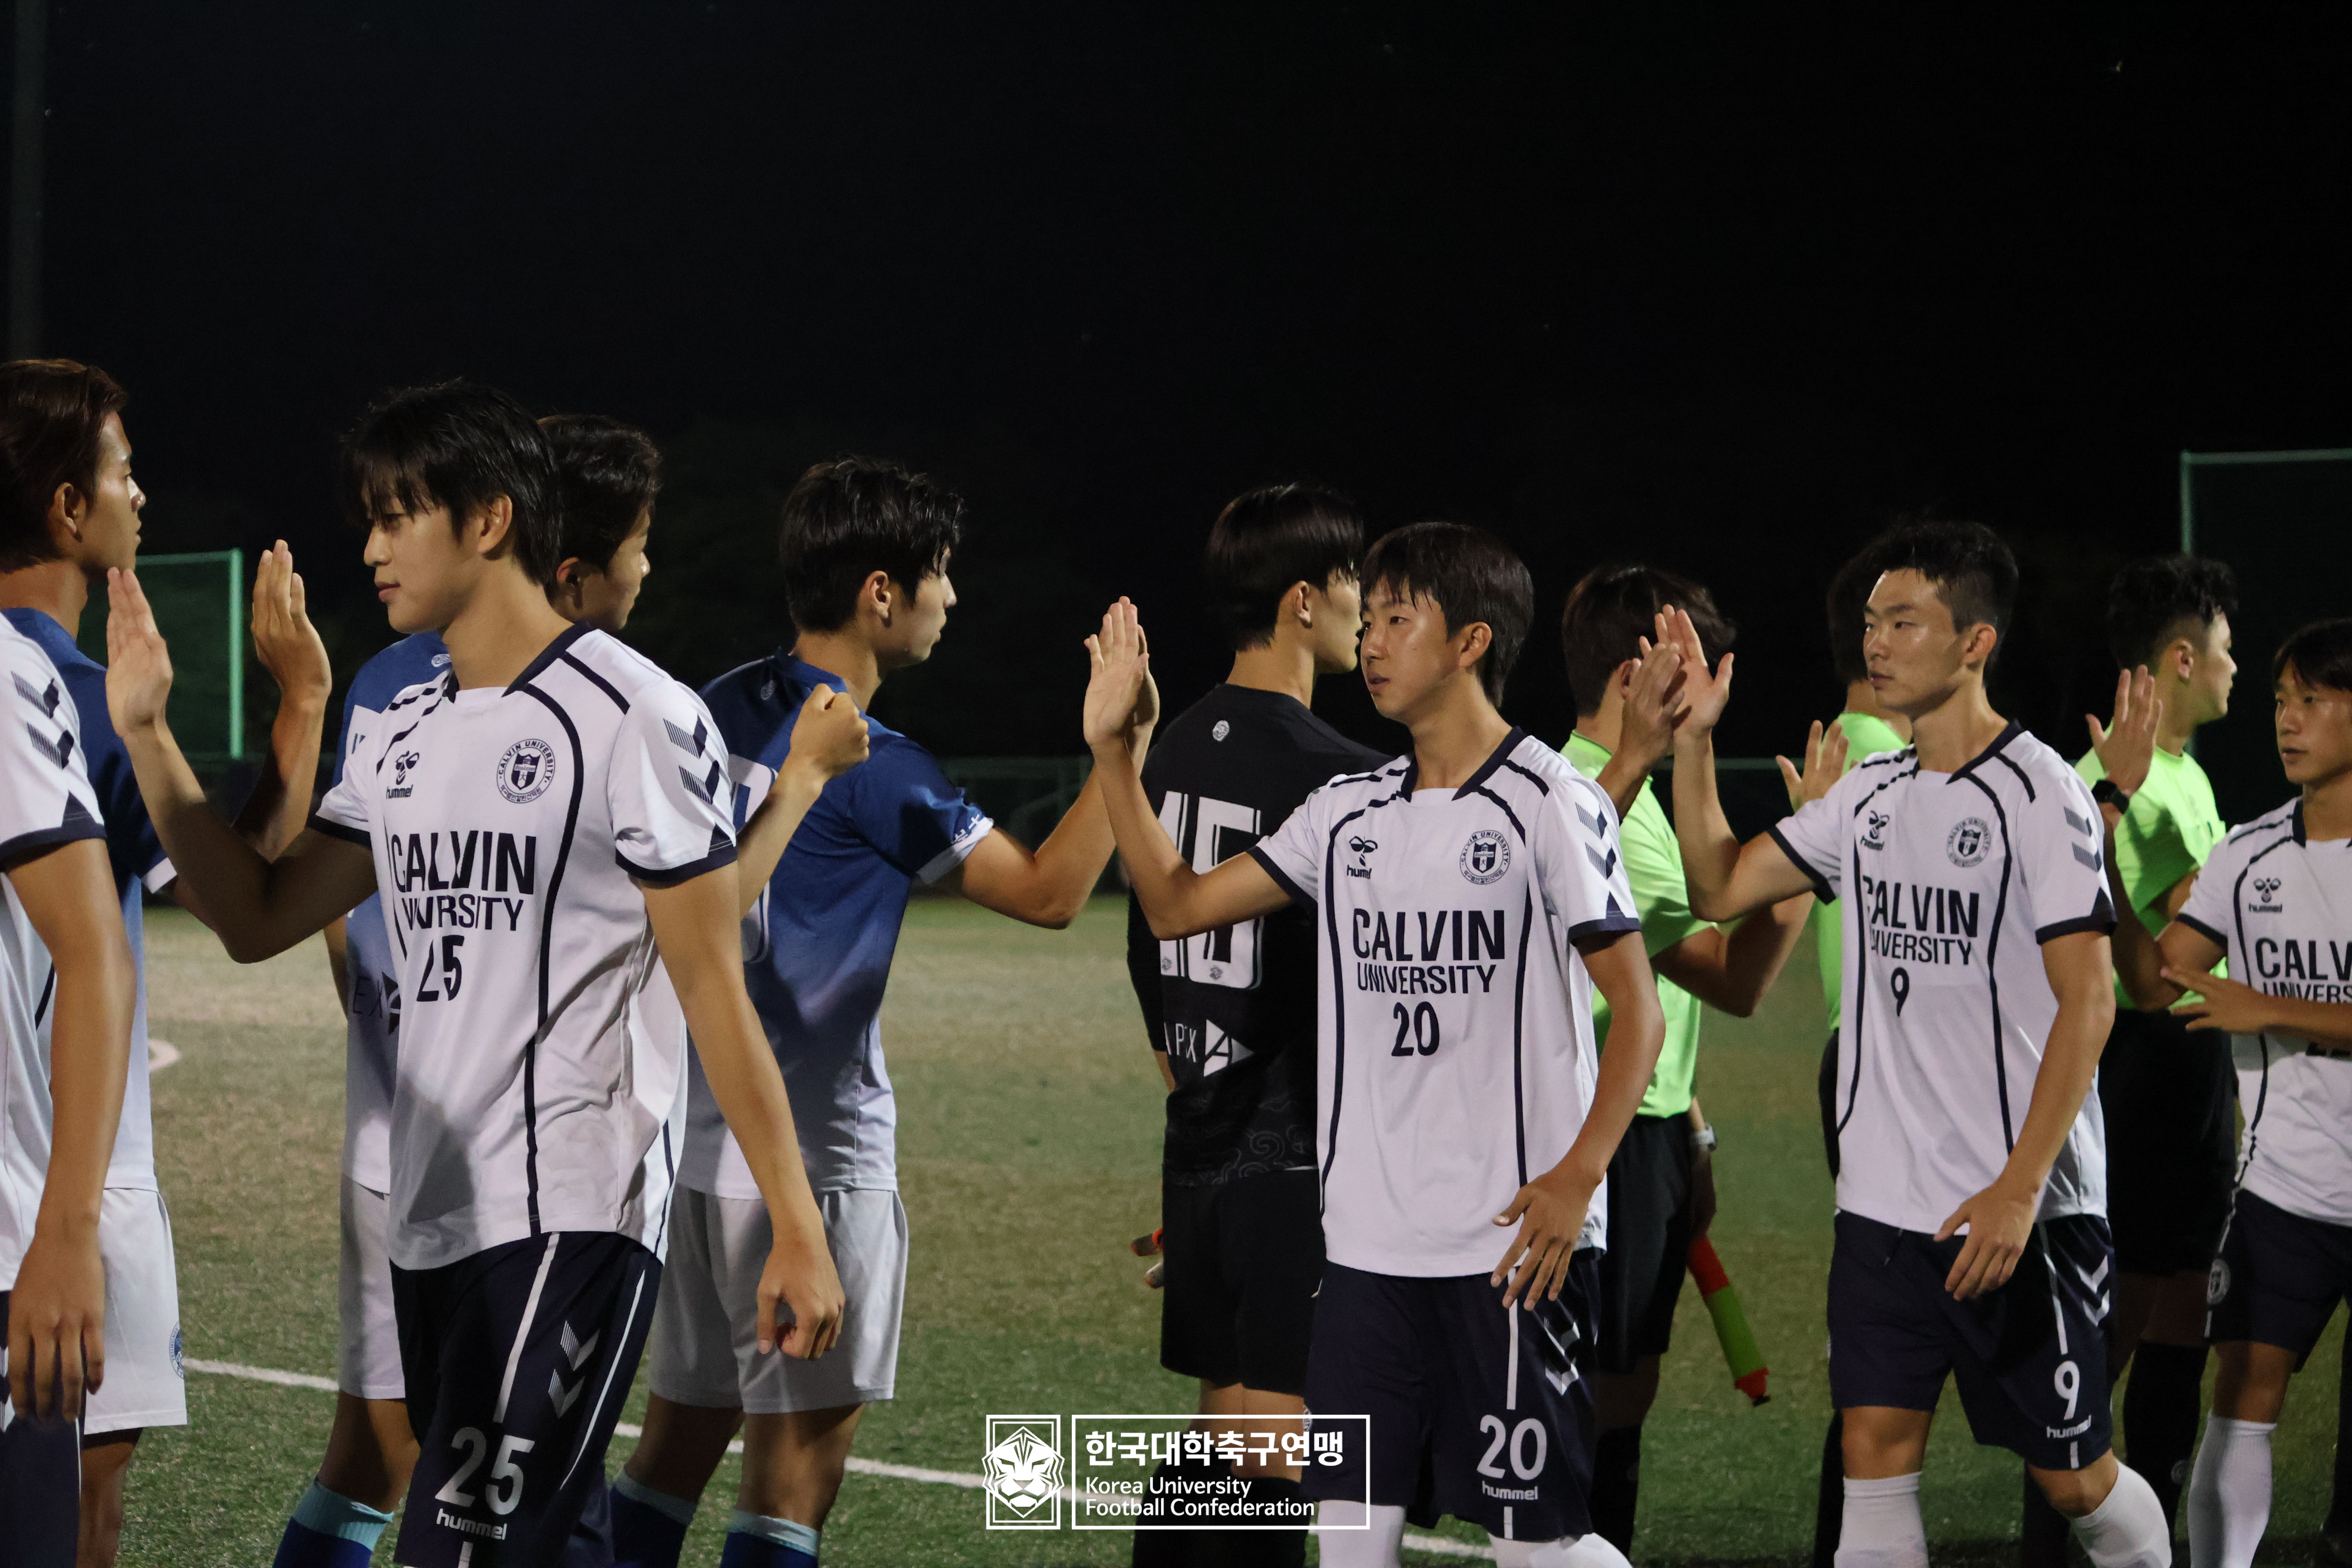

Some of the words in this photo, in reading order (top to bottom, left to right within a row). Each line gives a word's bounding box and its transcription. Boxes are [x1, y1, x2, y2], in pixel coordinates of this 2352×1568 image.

[499, 744, 521, 775] CALVIN
[525, 740, 554, 781] UNIVERSITY
[386, 784, 413, 799] hummel
[392, 830, 536, 895] CALVIN
[1481, 831, 1509, 863] UNIVERSITY
[1353, 908, 1505, 962] CALVIN
[417, 935, 465, 1002] 25
[1357, 962, 1497, 995] UNIVERSITY
[1891, 967, 1910, 1017] 9
[1391, 1002, 1440, 1057] 20
[2054, 1361, 2080, 1420] 9
[435, 1427, 535, 1515] 25
[1477, 1414, 1547, 1481] 20
[1482, 1481, 1539, 1501] hummel
[436, 1508, 507, 1541] hummel
